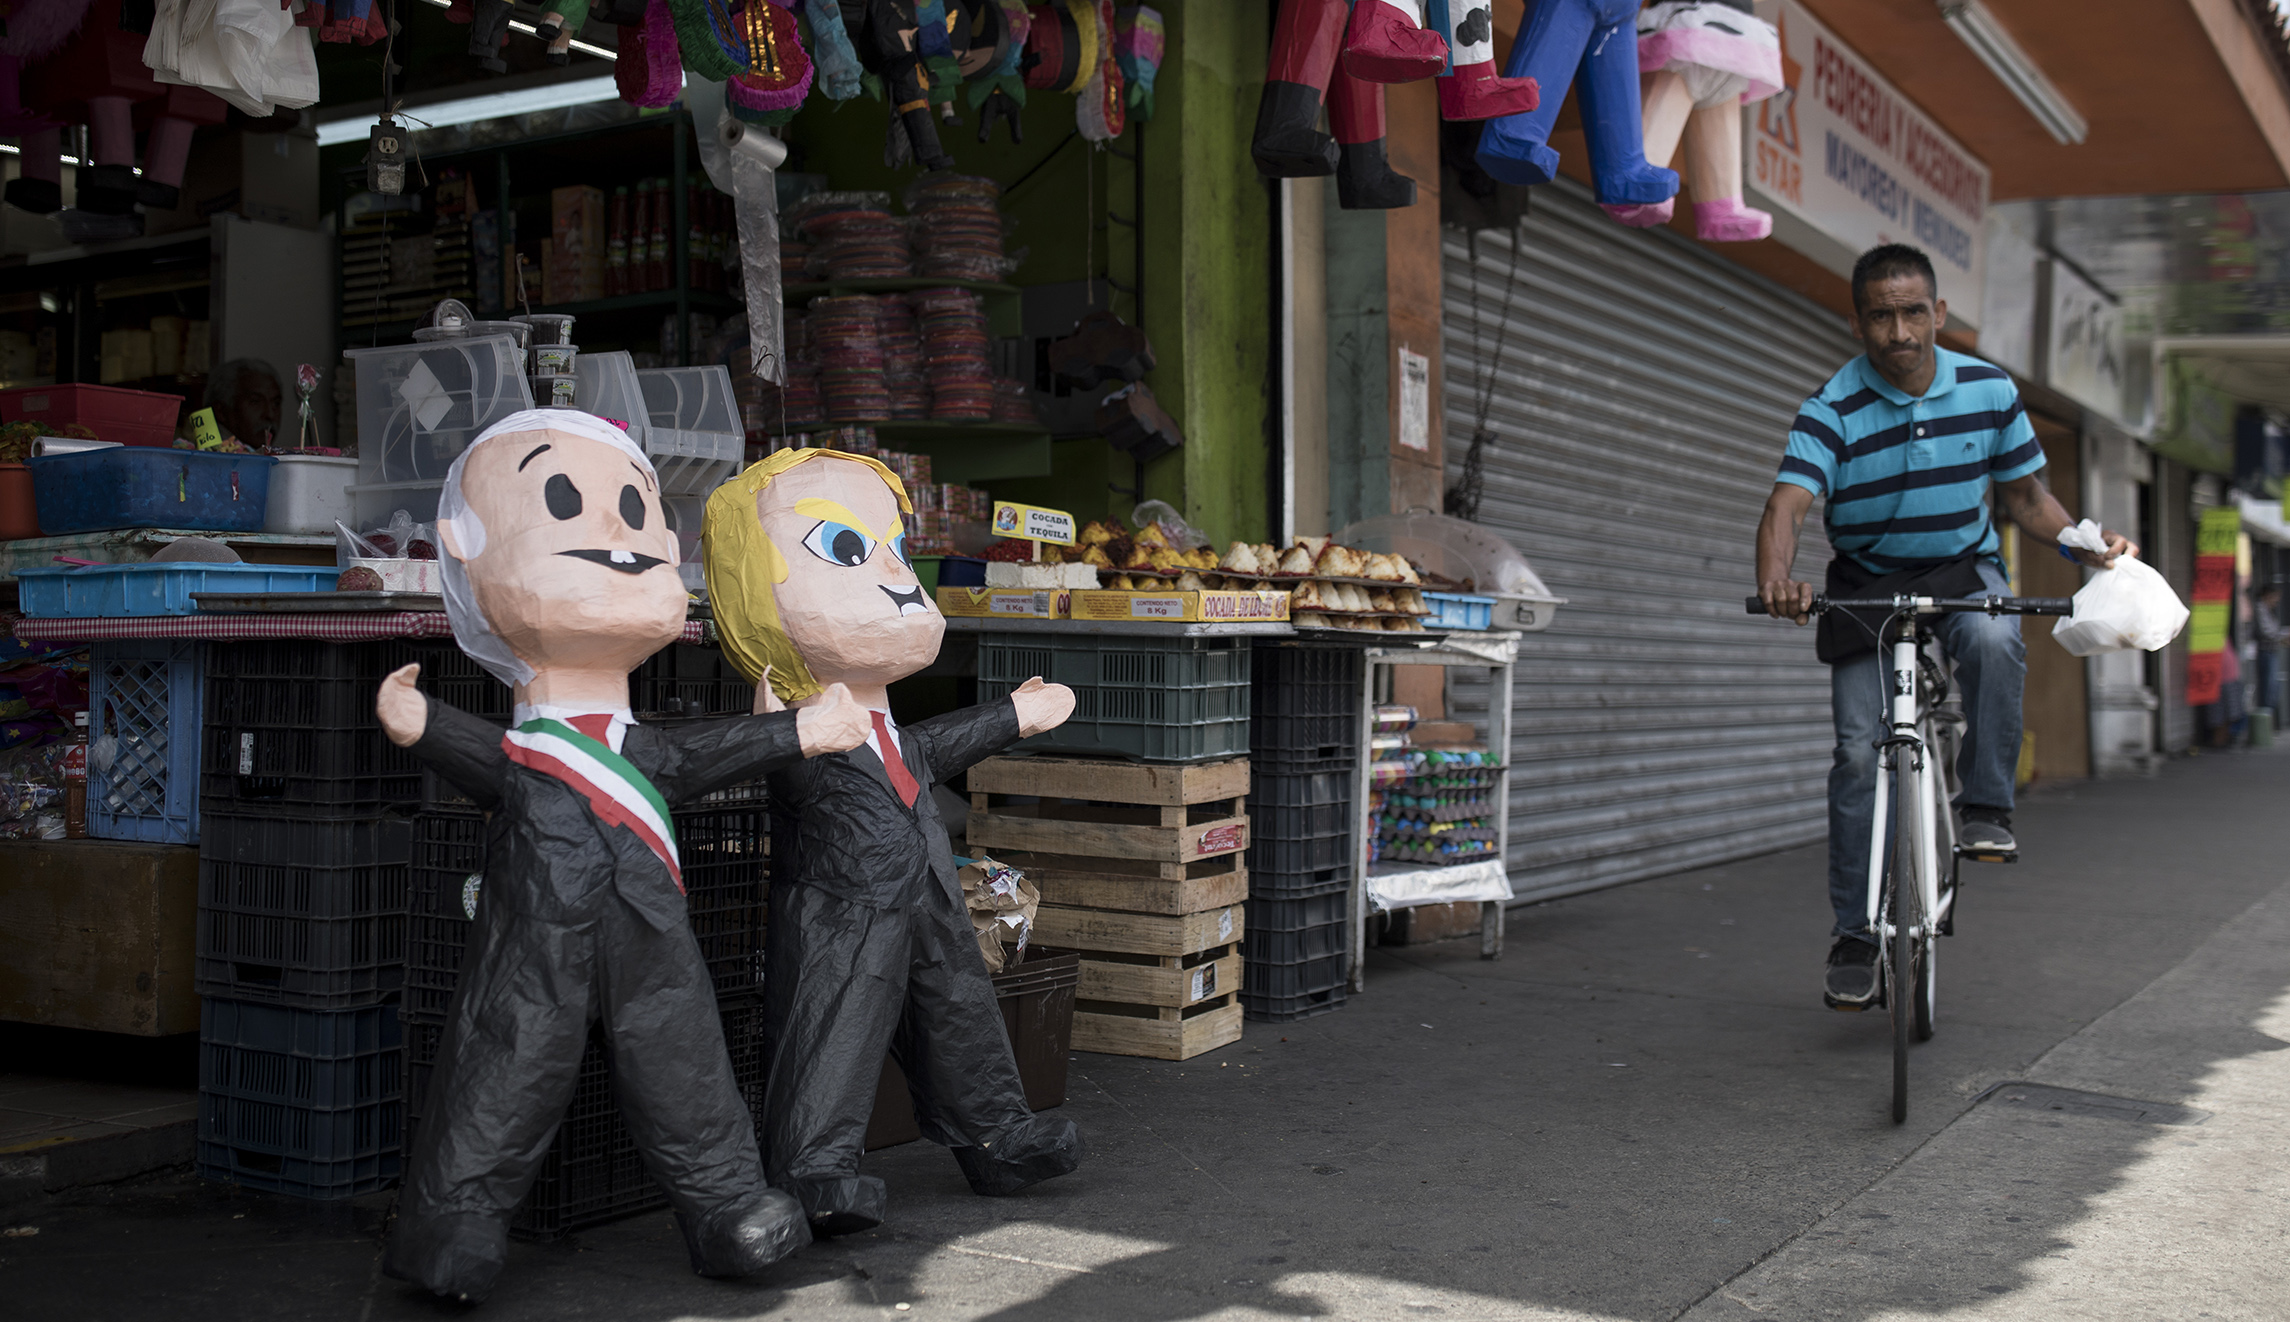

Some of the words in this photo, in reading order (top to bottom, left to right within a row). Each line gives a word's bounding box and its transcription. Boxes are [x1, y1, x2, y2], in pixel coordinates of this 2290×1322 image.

[1757, 139, 1803, 205] STAR
[1032, 513, 1068, 525] COCADA
[1030, 527, 1068, 540] TEQUILA
[1012, 604, 1024, 612] Kg
[1204, 596, 1236, 618] COCADA
[1237, 596, 1248, 618] DE
